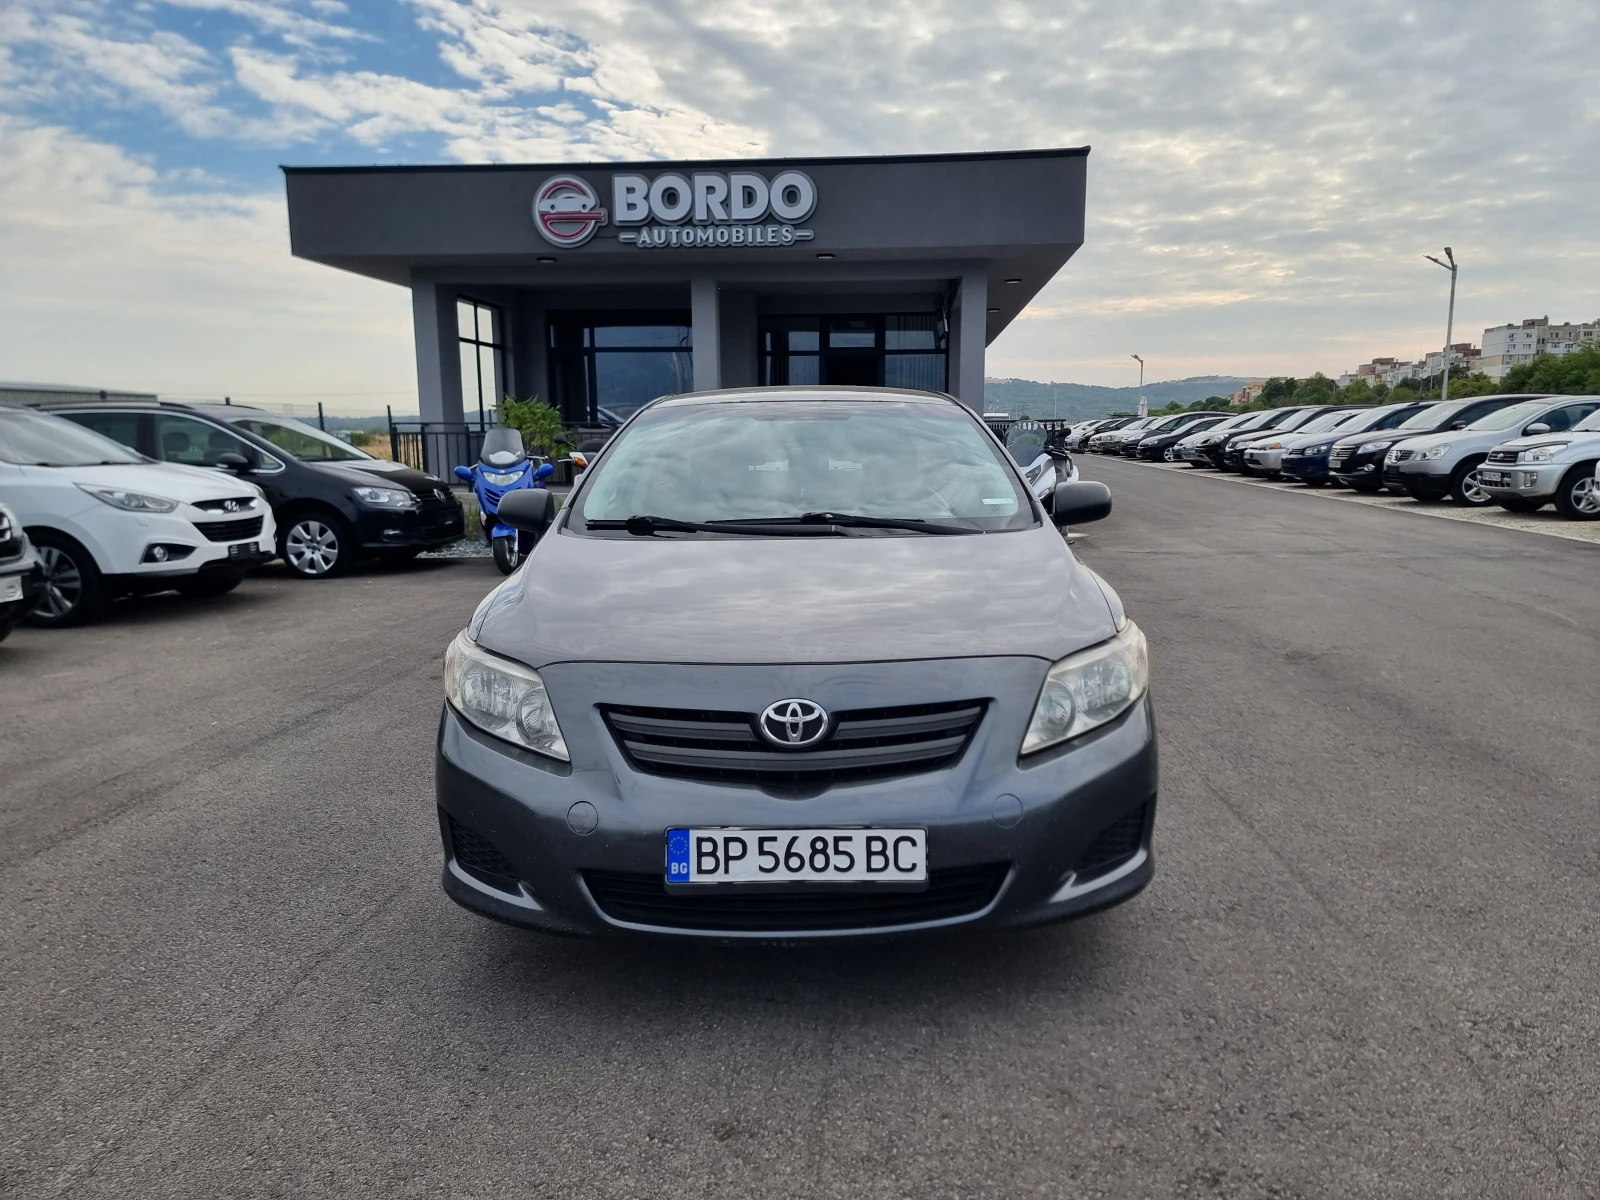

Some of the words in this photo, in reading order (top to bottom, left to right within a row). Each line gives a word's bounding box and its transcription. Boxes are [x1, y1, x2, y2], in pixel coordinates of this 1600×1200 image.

[613, 172, 815, 222] BORDO
[638, 226, 793, 246] AUTOMOBILES
[670, 862, 688, 875] BG
[695, 835, 748, 875] BP
[757, 835, 856, 874] 5685
[865, 835, 918, 874] BC
